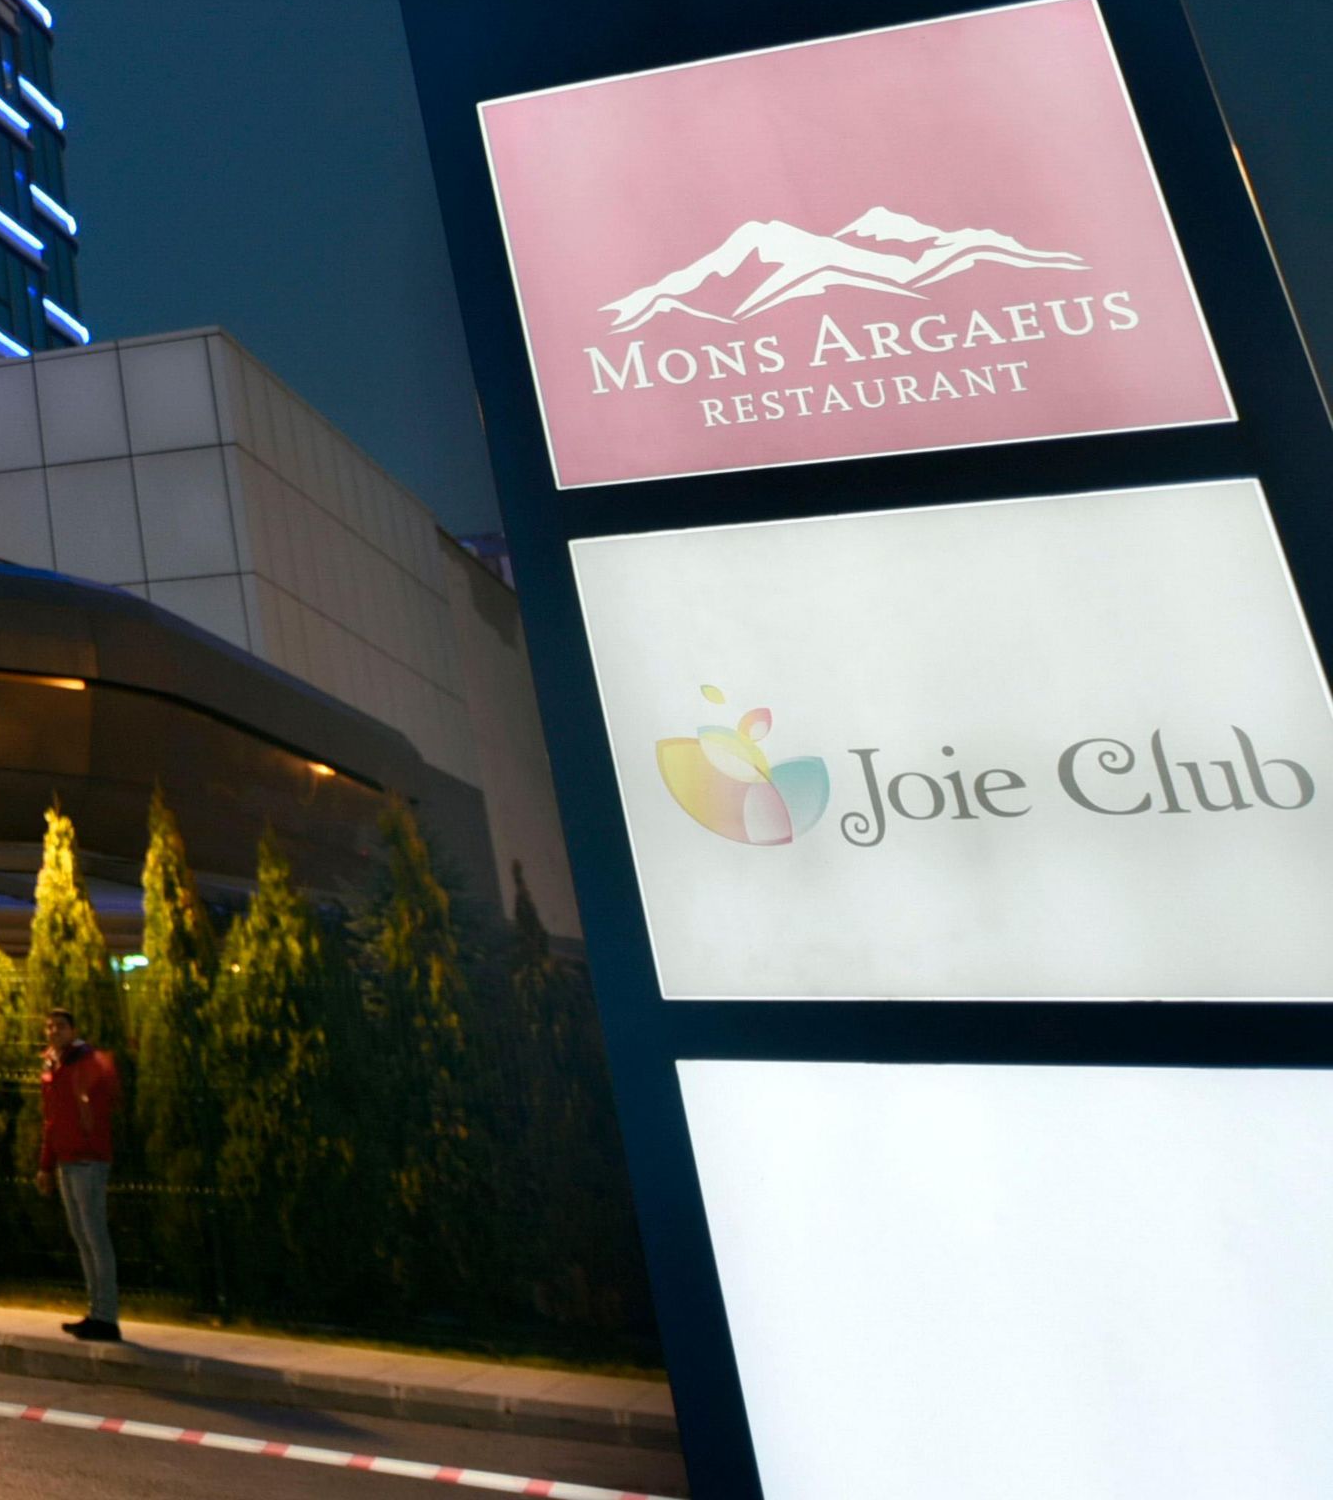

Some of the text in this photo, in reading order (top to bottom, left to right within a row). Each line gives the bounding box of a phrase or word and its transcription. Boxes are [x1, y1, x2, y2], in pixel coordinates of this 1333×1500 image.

[699, 360, 1030, 428] RESTAURANT
[839, 724, 1316, 848] Joie Club
